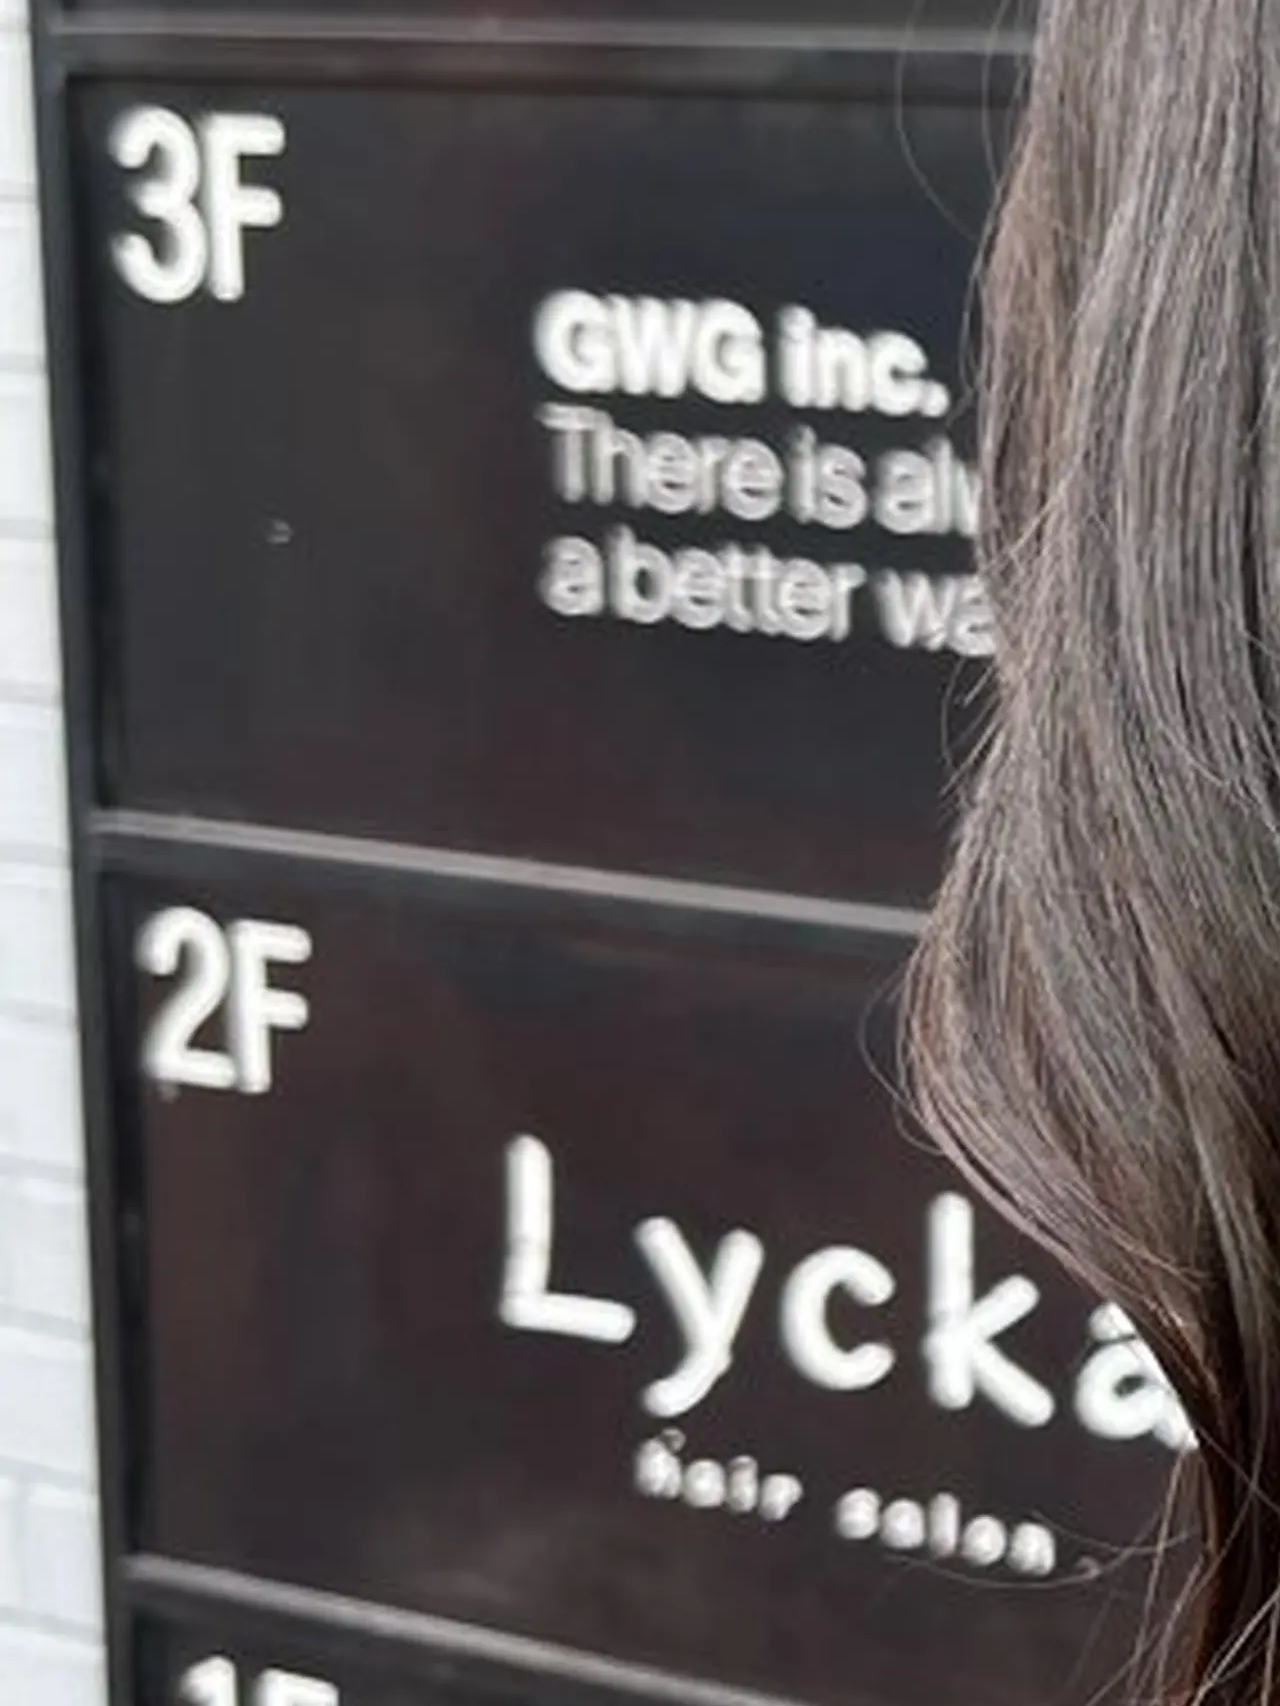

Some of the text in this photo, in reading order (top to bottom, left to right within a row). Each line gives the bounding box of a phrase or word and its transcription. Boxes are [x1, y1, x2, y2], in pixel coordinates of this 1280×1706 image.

[108, 104, 286, 303] 3F
[535, 290, 950, 418] GWG inc.
[537, 403, 783, 521] There
[790, 425, 868, 530] is
[540, 535, 603, 617] a
[606, 525, 867, 643] better
[135, 905, 312, 1095] 2F
[500, 1133, 1199, 1451] Lycka
